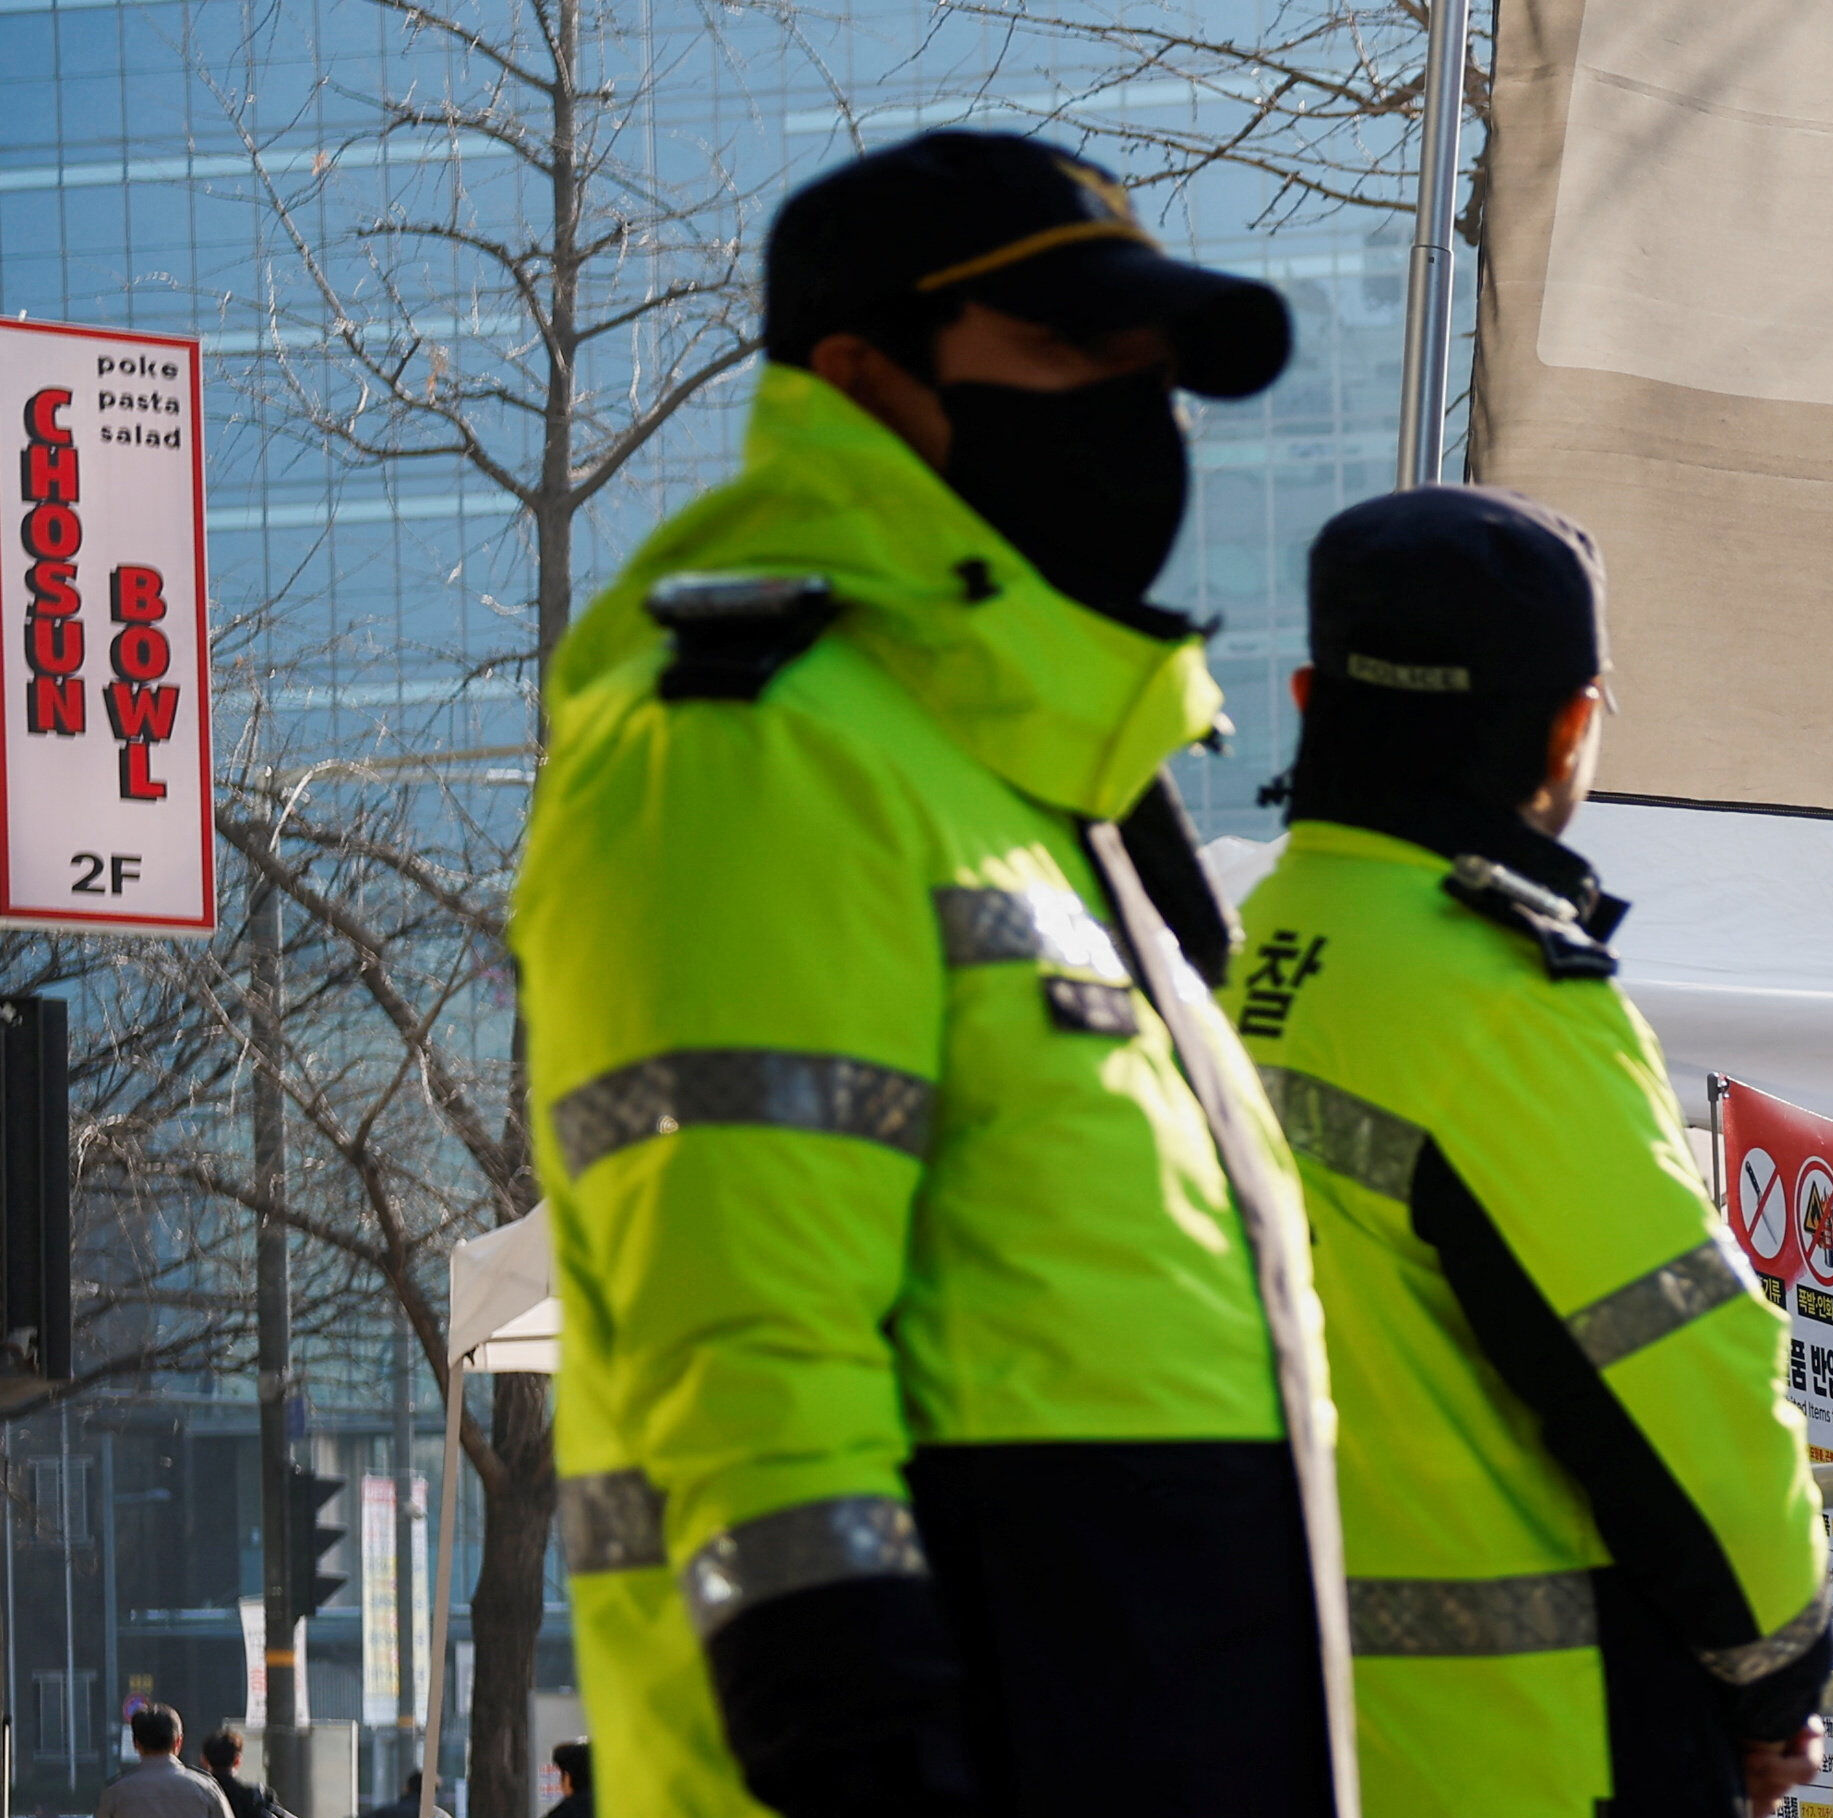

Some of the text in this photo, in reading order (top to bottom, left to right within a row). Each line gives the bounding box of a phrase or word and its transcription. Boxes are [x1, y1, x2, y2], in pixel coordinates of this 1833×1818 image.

[98, 353, 179, 381] poke
[98, 385, 181, 417] pasta
[100, 424, 182, 449] salad
[20, 387, 86, 736] CHOSUN
[103, 563, 180, 802] BOWL
[70, 853, 142, 896] 2F
[1809, 1403, 1830, 1424] Items
